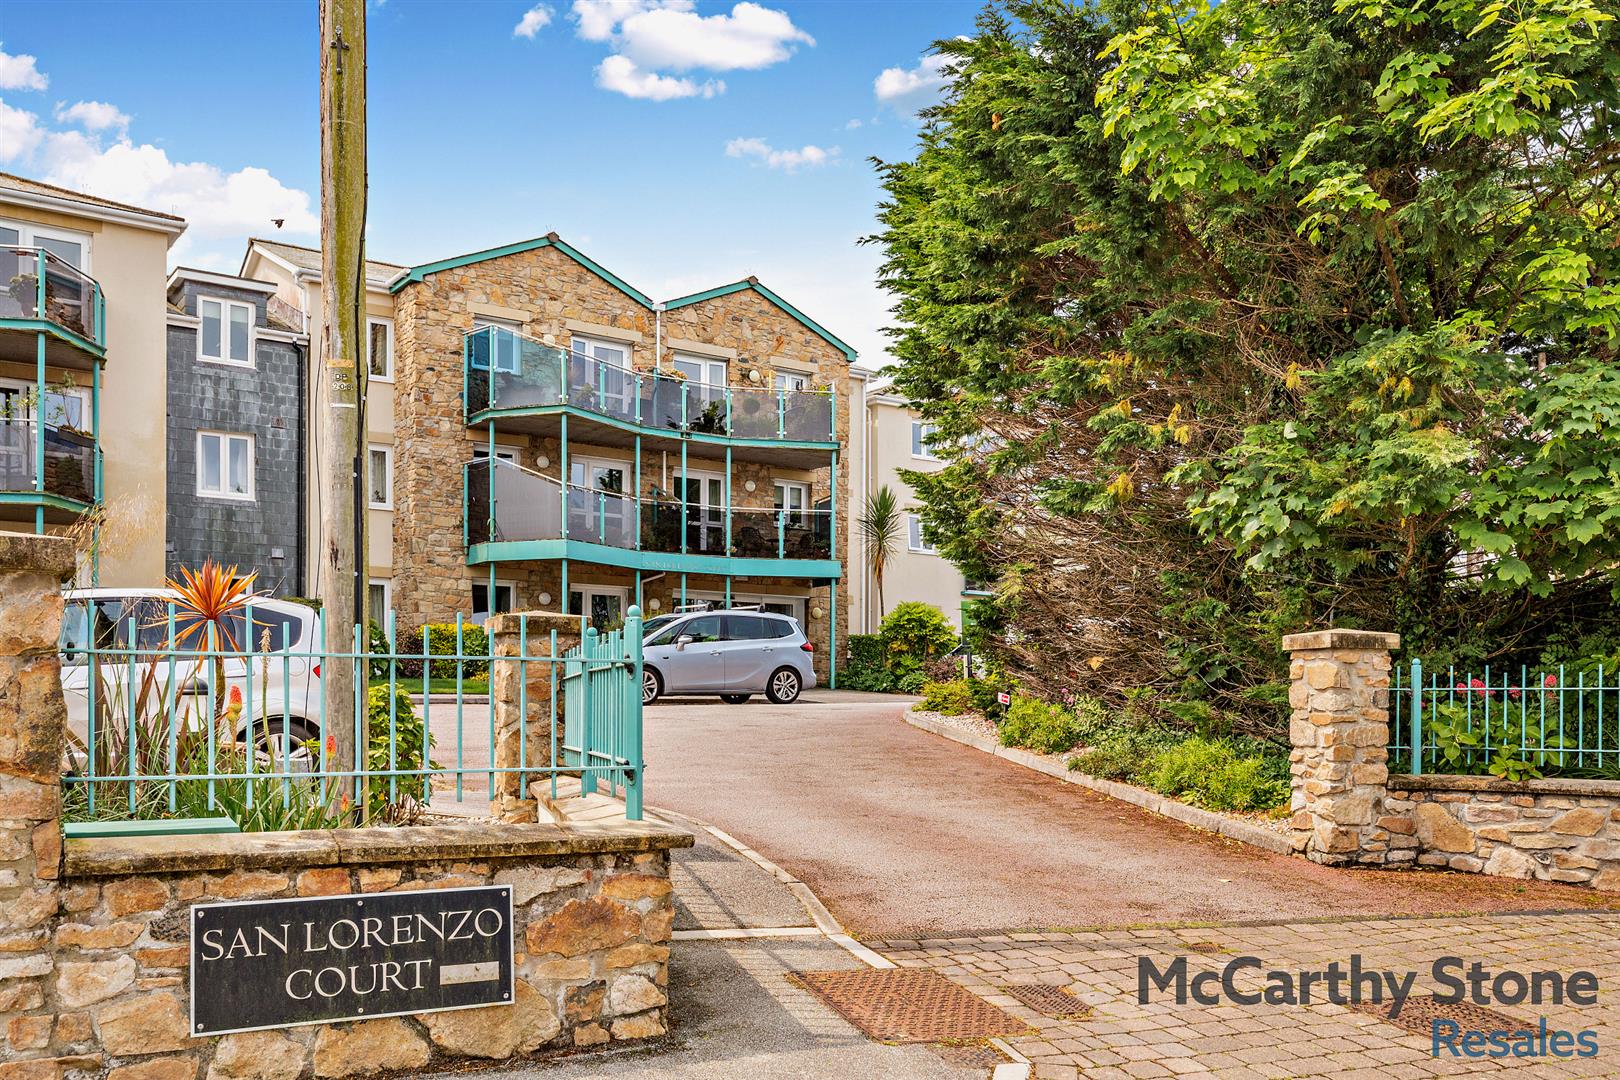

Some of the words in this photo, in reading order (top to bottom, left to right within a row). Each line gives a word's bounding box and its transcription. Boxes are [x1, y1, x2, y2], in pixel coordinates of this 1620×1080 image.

[201, 924, 290, 961] SAN
[303, 908, 503, 953] LORENZO
[285, 959, 432, 1000] COURT
